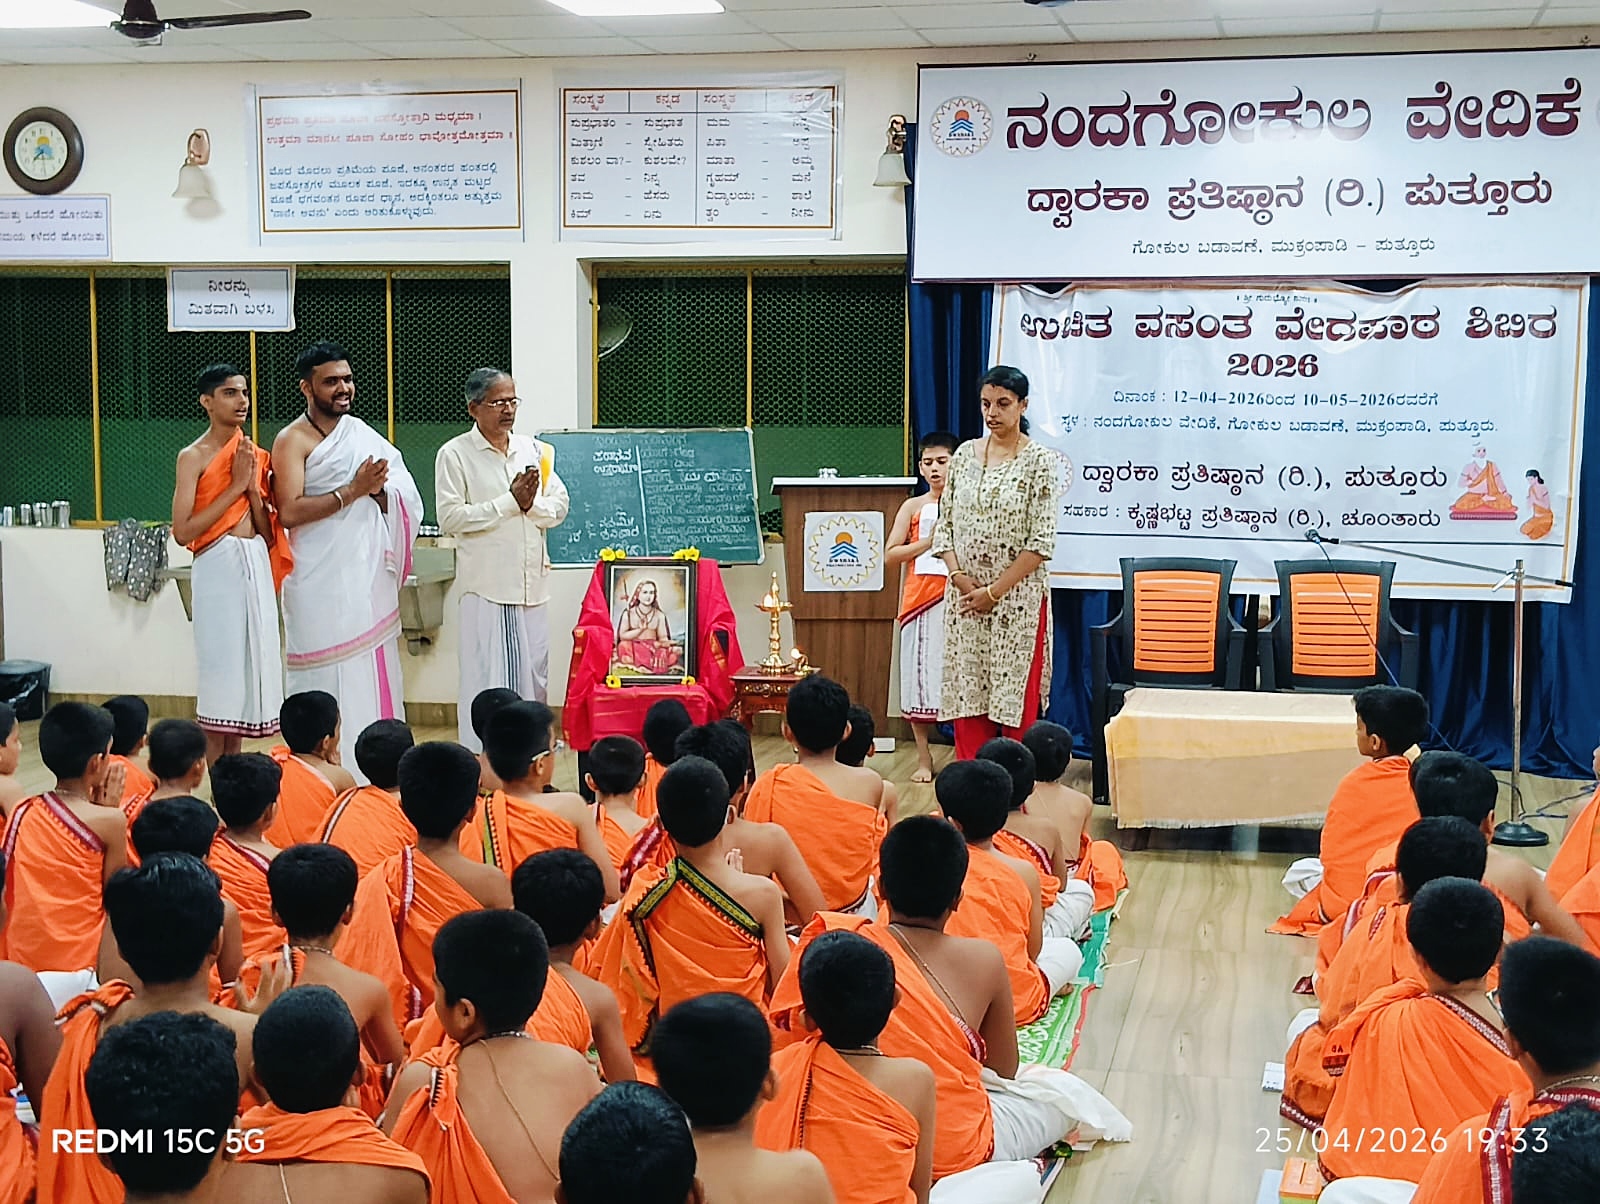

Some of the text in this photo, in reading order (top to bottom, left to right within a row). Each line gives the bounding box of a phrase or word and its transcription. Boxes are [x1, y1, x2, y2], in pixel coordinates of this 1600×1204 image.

[655, 94, 681, 109] ಕನ್ನಡ
[1006, 77, 1582, 149] ನಂದಗೋಕುಲ ವೇದಿಕೆ
[1027, 171, 1552, 228] ದ್ವಾರಕಾ ಪ್ರತಿಷ್ಠಾನ (ರಿ.) ಪುತ್ತೂರು
[1132, 239, 1190, 255] ಗೋಕುಲ
[1198, 238, 1262, 254] ಬಡಾವಣೆ,
[1271, 238, 1348, 257] ಮುಕ್ರಂಪಾಡಿ
[1375, 237, 1435, 257] ಪುತ್ತೂರು
[208, 279, 251, 298] ನೀರನ್ನು
[188, 303, 238, 315] ಮಿತವಾಗಿ
[1020, 305, 1557, 341] ಉಚಿತ ವಸಂತ ವೇದಪಾಠ ಶಿಬಿರ
[1227, 352, 1319, 378] 2026
[1113, 390, 1156, 403] ದಿನಾಂಕ
[1061, 414, 1079, 433] ಸ್ಥಳ
[1093, 414, 1172, 429] ನಂದಗೋಕುಲ
[1179, 416, 1220, 431] ವೇದಿಕೆ,
[1228, 416, 1282, 431] ಗೋಕುಲ
[1289, 418, 1349, 433] ಬಡಾವಣೆ,
[1356, 419, 1431, 437] ಮುಕ್ರಂಪಾಡಿ,
[1082, 460, 1447, 496] ದ್ವಾರಕಾ ಪ್ರತಿಷ್ಠಾನ (ರಿ.), ಪುತ್ತೂರು
[1063, 504, 1108, 518] ಸಹಕಾರ
[1127, 502, 1192, 530] ಕೃಷ್ಣಭಟ್ಟ
[1202, 505, 1278, 533] ಪ್ರತಿಷ್ಠಾನ
[1288, 509, 1331, 529] (ರಿ.),
[1341, 509, 1441, 528] ಚೂಂತಾರು
